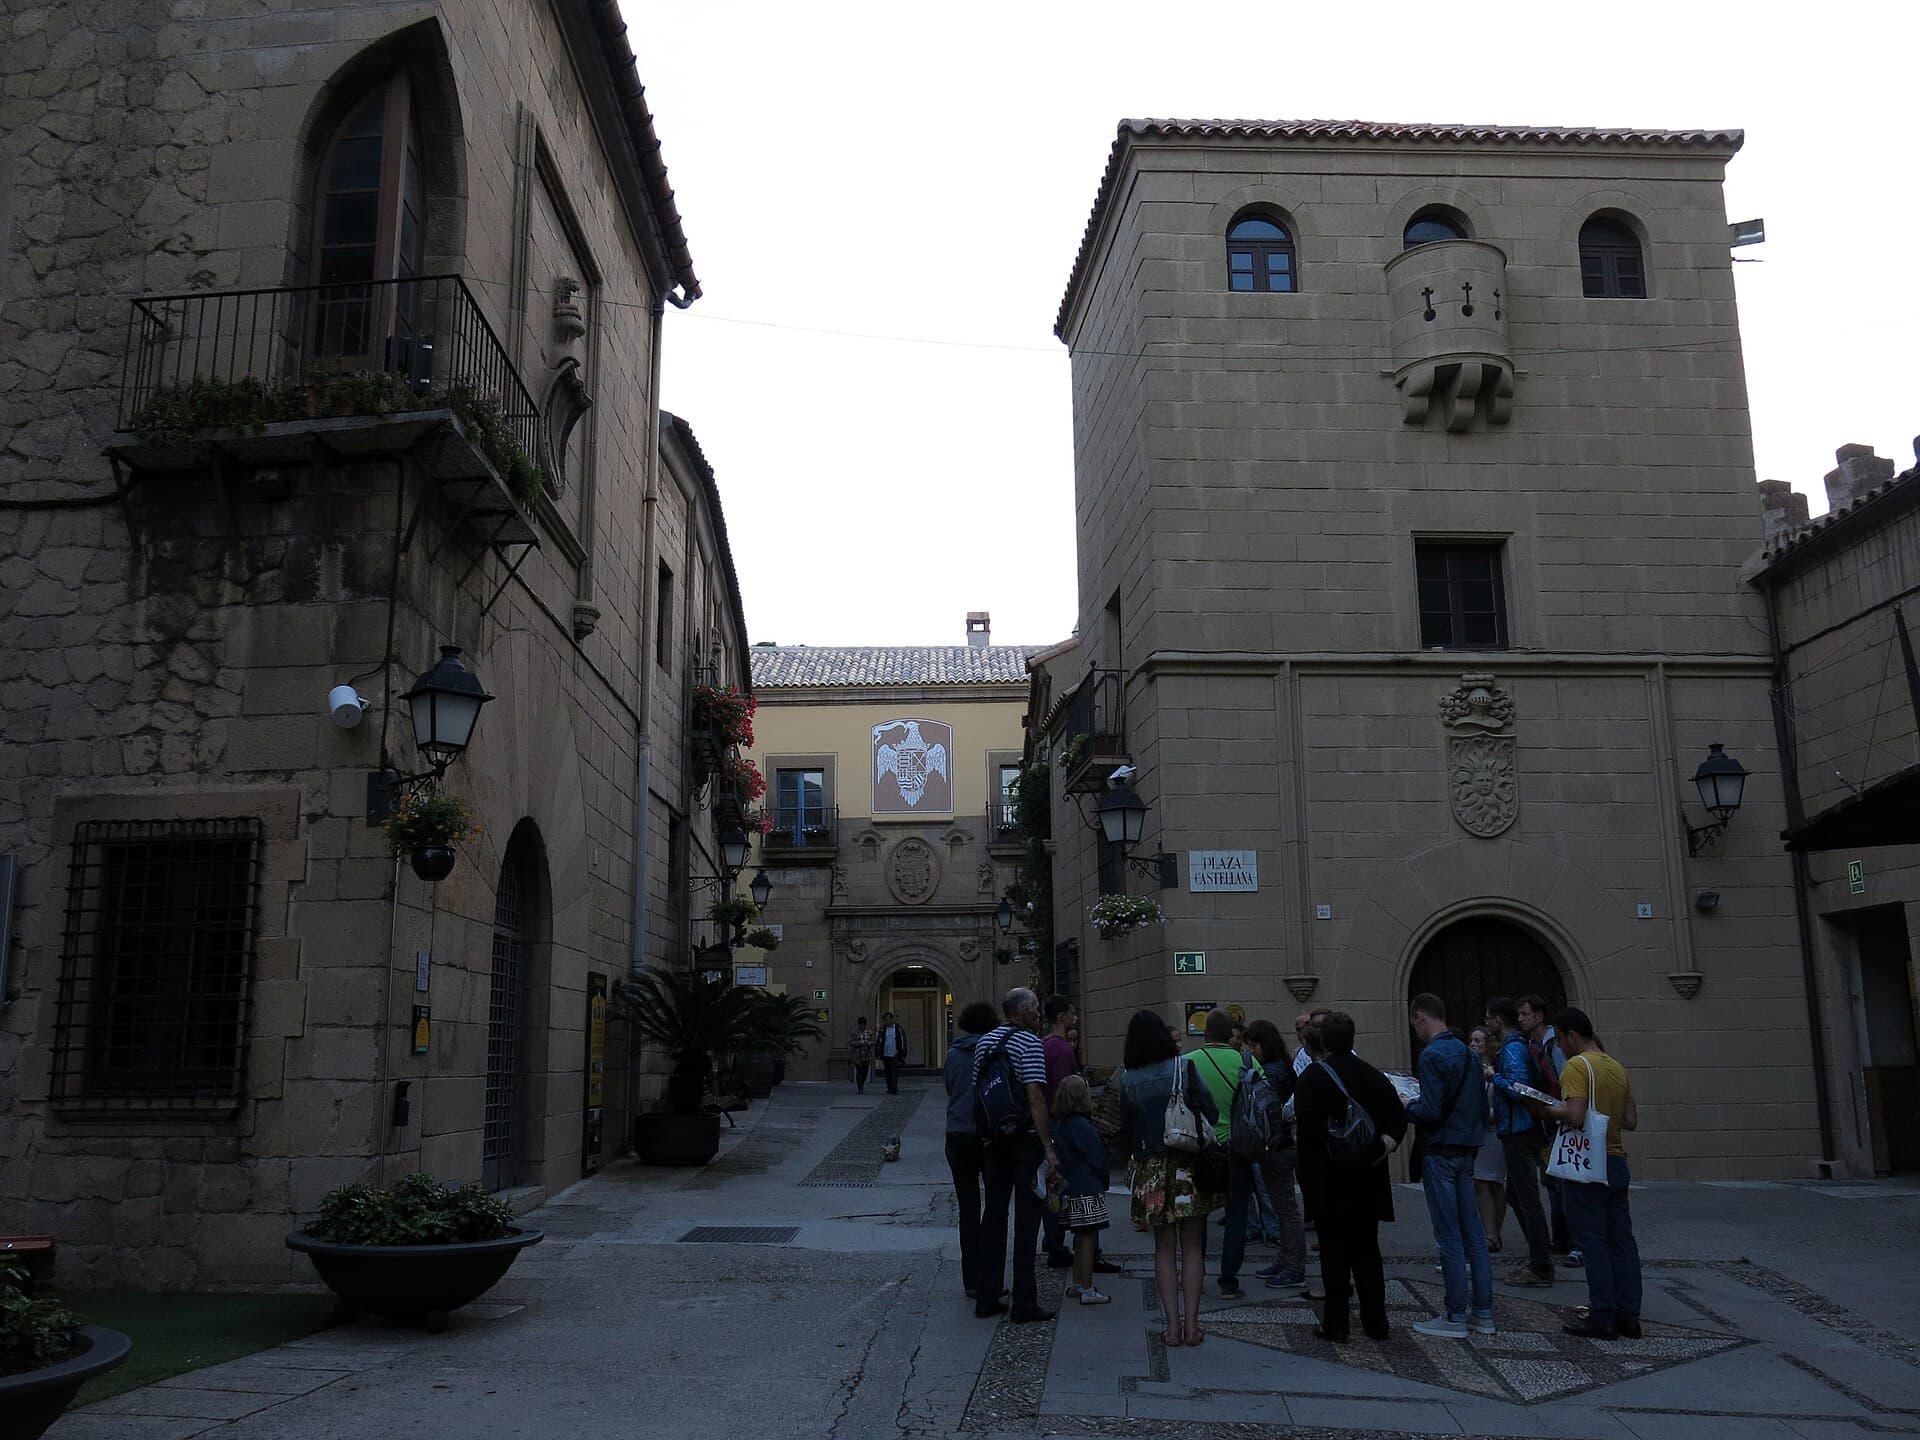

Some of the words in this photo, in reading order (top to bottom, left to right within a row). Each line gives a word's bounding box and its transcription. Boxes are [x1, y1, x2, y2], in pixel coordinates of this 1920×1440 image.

[1203, 857, 1241, 869] PLAZA
[1194, 871, 1254, 885] CASTELLANA
[1557, 1148, 1592, 1171] Life
